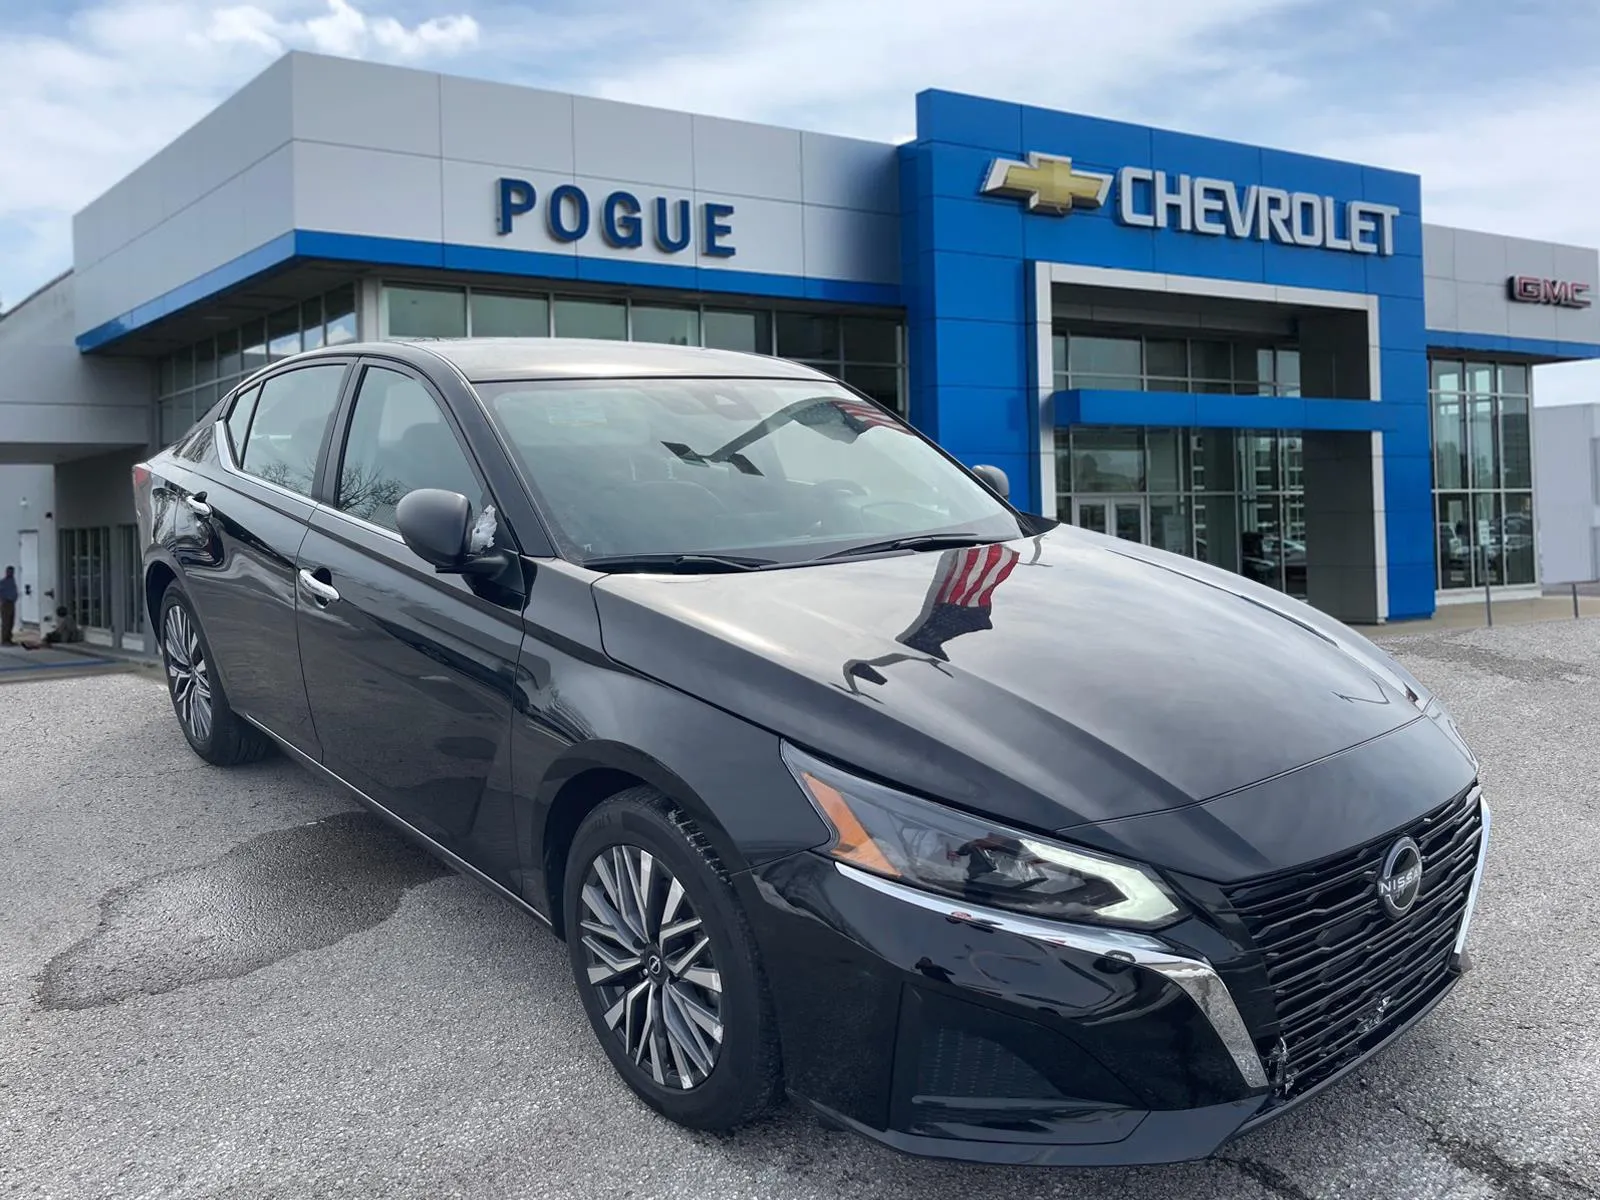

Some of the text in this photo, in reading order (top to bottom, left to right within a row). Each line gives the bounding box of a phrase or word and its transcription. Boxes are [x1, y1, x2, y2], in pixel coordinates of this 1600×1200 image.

[495, 177, 736, 258] POGUE
[1116, 165, 1400, 256] CHEVROLET
[1508, 275, 1591, 309] GMC
[1379, 867, 1421, 894] NISSA
